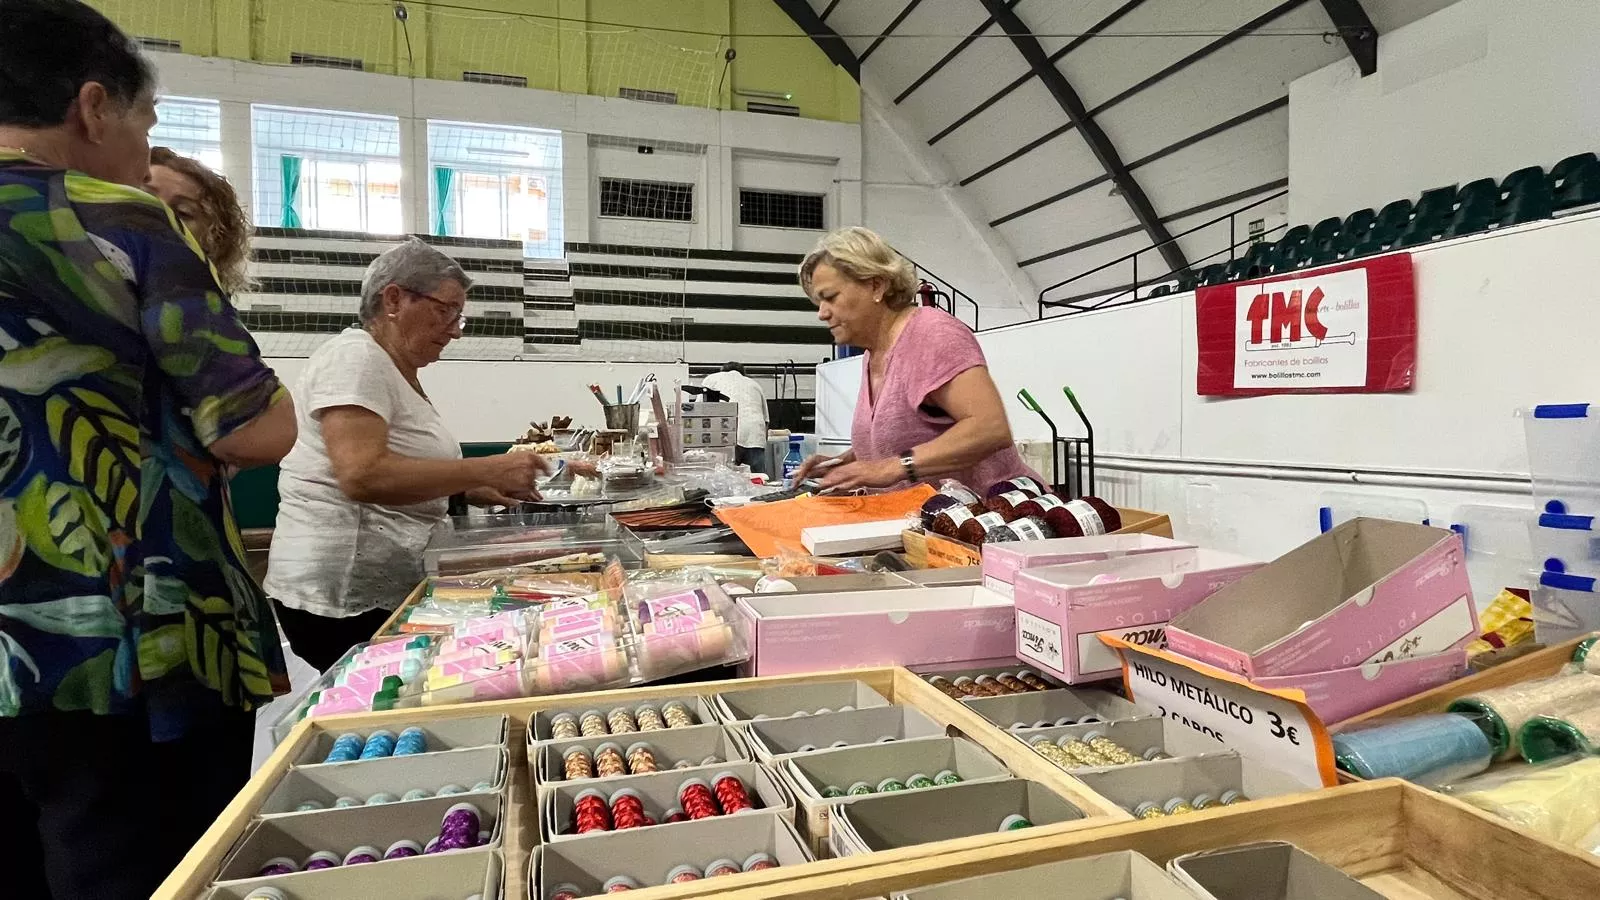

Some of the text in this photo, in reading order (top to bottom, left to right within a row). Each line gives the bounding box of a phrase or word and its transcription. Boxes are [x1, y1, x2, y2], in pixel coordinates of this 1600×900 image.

[1247, 286, 1328, 344] TMC
[1244, 356, 1329, 368] Fabricantes de bolillos
[1251, 371, 1321, 379] www.bolillostmc.com
[1121, 628, 1169, 650] inca
[1133, 661, 1300, 746] HILO METÁLICO 3€
